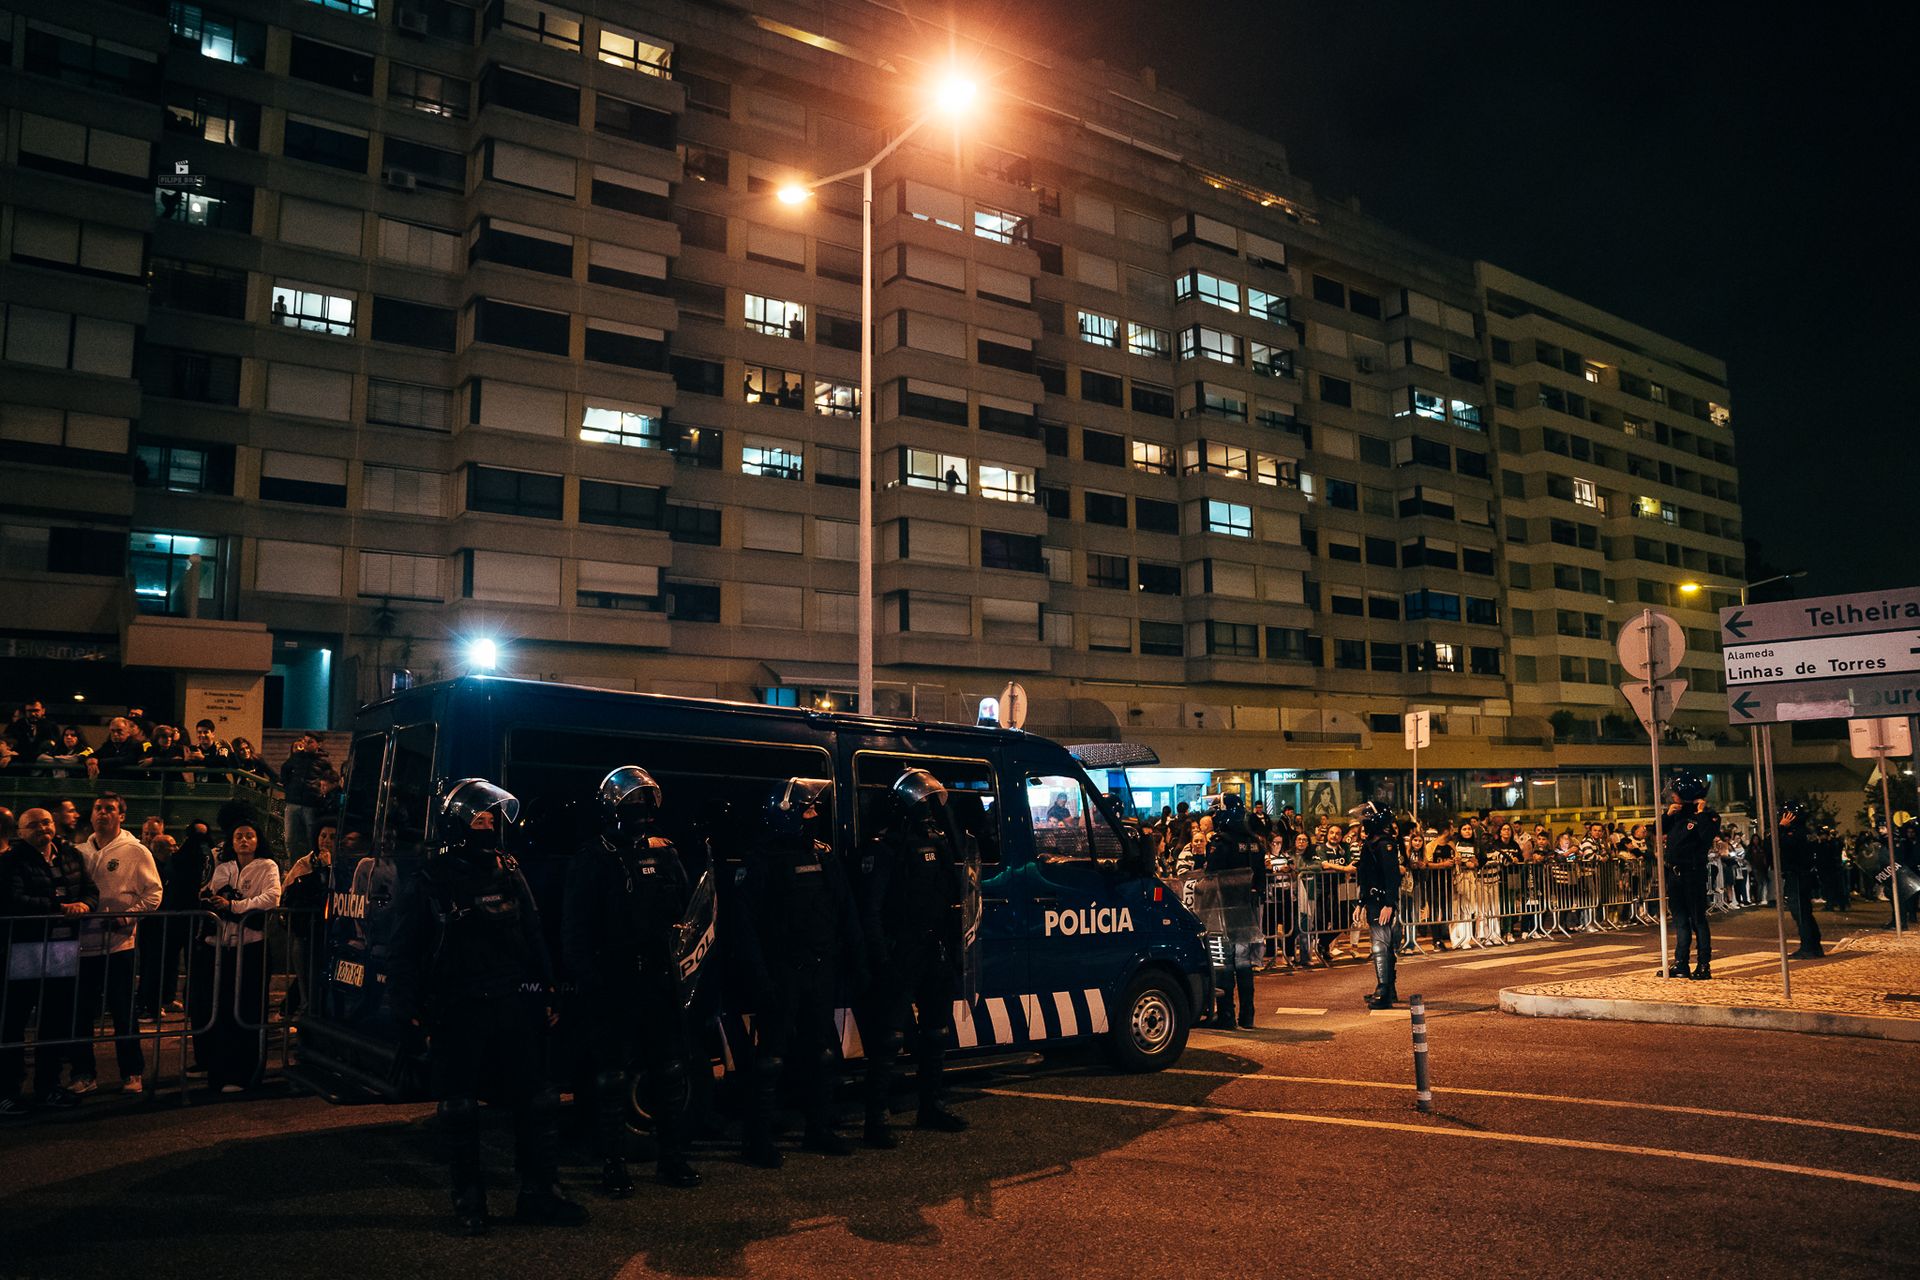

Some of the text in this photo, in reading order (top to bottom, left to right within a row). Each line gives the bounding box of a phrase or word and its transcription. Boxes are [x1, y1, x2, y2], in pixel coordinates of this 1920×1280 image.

[1727, 649, 1775, 661] Alameda
[1728, 658, 1887, 680] Linhas de Torres
[925, 852, 936, 861] EIR
[642, 867, 656, 875] EIR
[1044, 901, 1134, 937] POLÍCIA
